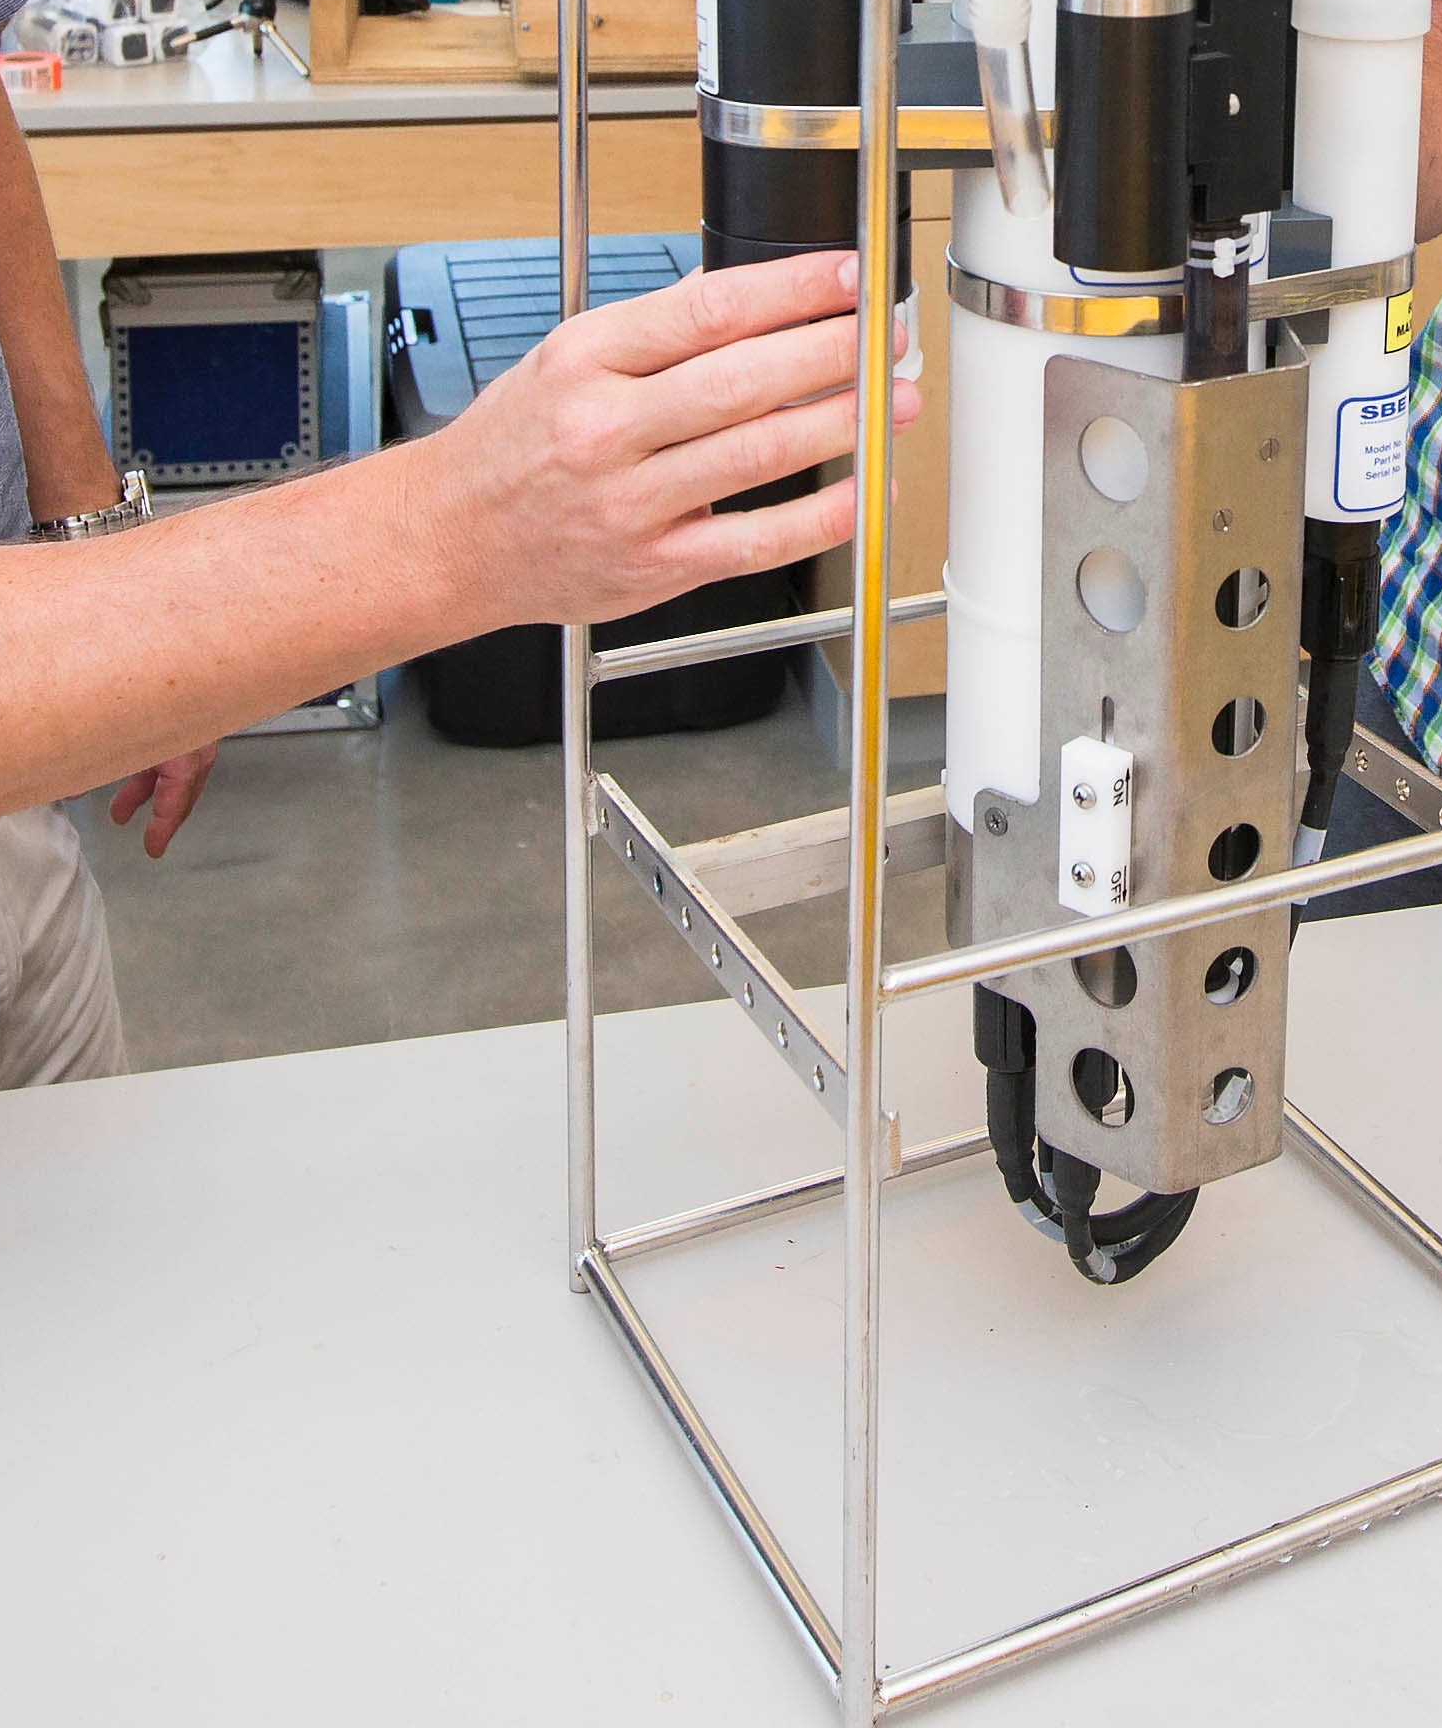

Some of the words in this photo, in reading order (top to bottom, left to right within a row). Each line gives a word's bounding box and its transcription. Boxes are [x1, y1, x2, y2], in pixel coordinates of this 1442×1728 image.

[1359, 397, 1406, 420] SBE
[1364, 442, 1392, 455] Model
[1373, 455, 1392, 466] Part
[1364, 468, 1391, 480] Serial
[1113, 778, 1124, 807] ON
[1110, 870, 1122, 904] OFF
